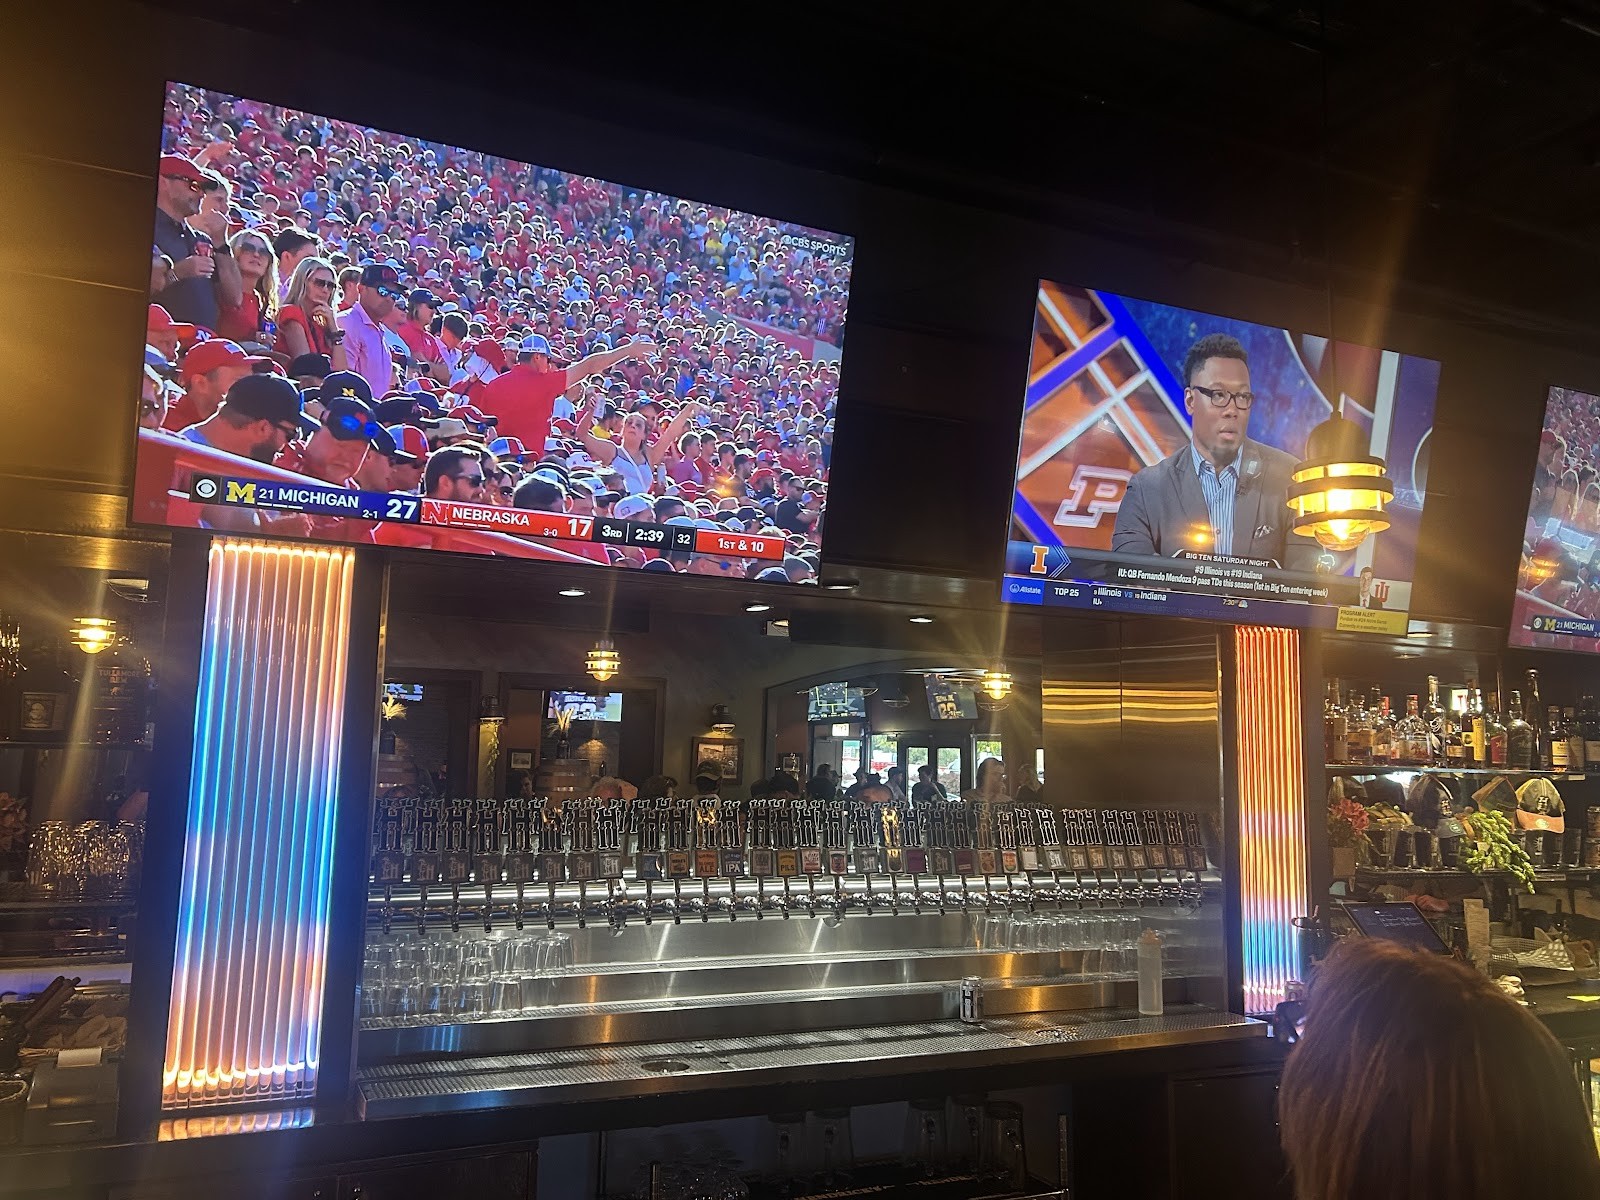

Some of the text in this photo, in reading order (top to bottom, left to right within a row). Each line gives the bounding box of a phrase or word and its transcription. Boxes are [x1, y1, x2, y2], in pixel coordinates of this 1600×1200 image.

[791, 236, 847, 257] CBS SPORTS
[226, 482, 417, 520] M 21 MICHIGAN 2-1 27
[420, 500, 592, 538] N NEBRASKA 3-0 17
[601, 524, 691, 545] 3RD 2:39 32
[717, 537, 764, 553] 1ST & 10
[1185, 552, 1270, 568] BIG TEN SATURDAY NIGHT
[1194, 565, 1263, 580] #9 Illinois vs #19 Indiana
[1117, 567, 1127, 577] IU:
[1127, 568, 1137, 579] QB
[1137, 569, 1165, 582] Fernando
[1165, 572, 1192, 584] Mendoza
[1196, 577, 1211, 586] pass
[1210, 577, 1222, 587] TDs
[1222, 579, 1234, 588] this
[1234, 581, 1254, 590] season
[1253, 580, 1265, 592] (1st
[1270, 583, 1280, 594] Big
[1280, 584, 1290, 593] Ten
[1290, 585, 1313, 597] entering
[1019, 586, 1042, 595] Allstate
[1054, 587, 1080, 597] TOP 25
[1097, 587, 1122, 598] Illinois
[1140, 590, 1167, 602] Indiana
[1543, 617, 1557, 631] M
[1563, 620, 1594, 632] MICHIGAN
[725, 864, 741, 873] IPA
